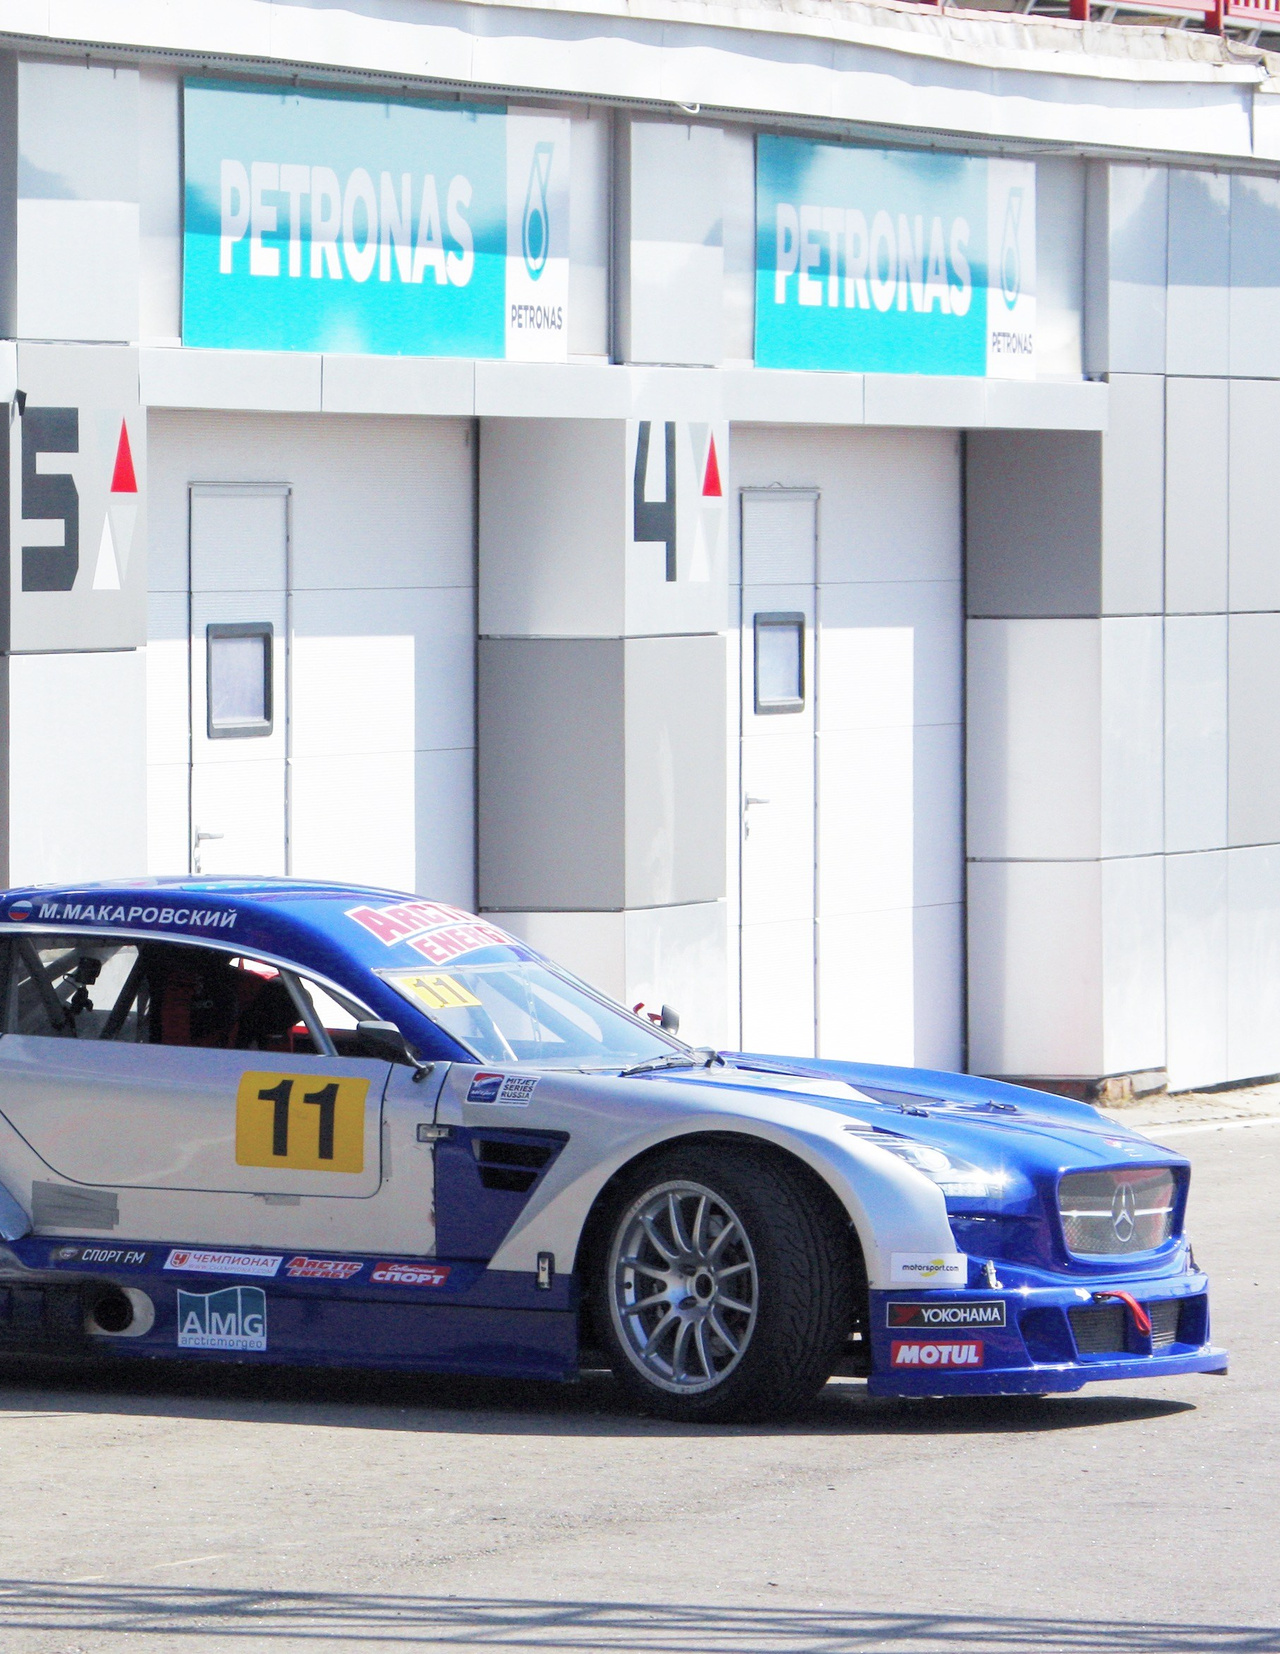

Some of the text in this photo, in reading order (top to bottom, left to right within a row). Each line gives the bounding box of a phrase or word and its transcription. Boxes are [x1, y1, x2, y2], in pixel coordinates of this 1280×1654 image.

[219, 158, 474, 287] PETRONAS
[775, 203, 972, 317] PETRONAS
[510, 304, 563, 331] PETRONAS
[992, 331, 1033, 354] PETRONAS
[21, 407, 79, 591] 5
[634, 421, 677, 582] 4
[38, 903, 237, 928] М.МАКАРОВСКИЙ
[413, 977, 467, 1005] 11
[503, 1084, 534, 1093] SERIES
[505, 1077, 538, 1087] MITJET
[500, 1091, 531, 1099] RUSSIA
[257, 1079, 337, 1160] 11
[81, 1248, 146, 1264] СПОРТ FM
[193, 1254, 278, 1267] ЧЕМПИОНАТ
[288, 1257, 362, 1271] ARCTIC
[372, 1270, 445, 1285] СПОРТ
[901, 1263, 960, 1273] motorsport.com
[182, 1311, 265, 1337] AMG
[921, 1307, 1001, 1322] YOKOHAMA
[181, 1336, 263, 1349] arcticmorgeo
[895, 1345, 979, 1364] MOTUL
